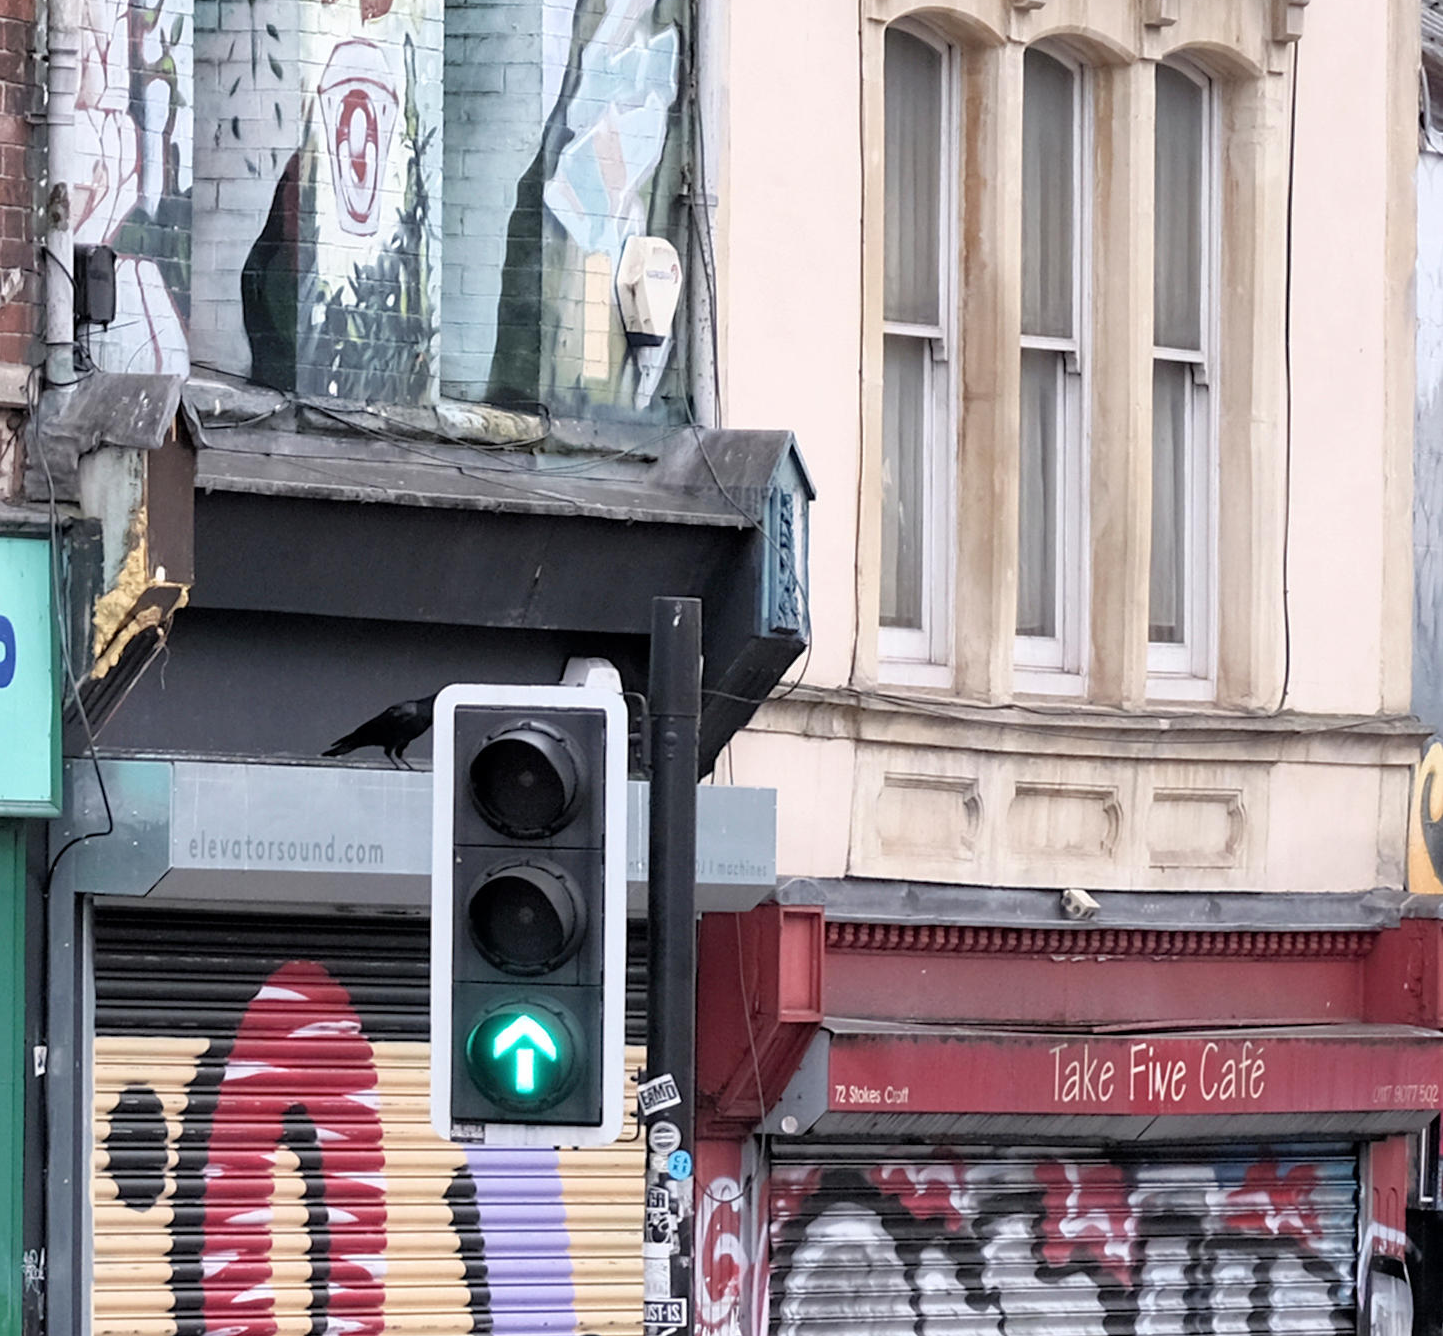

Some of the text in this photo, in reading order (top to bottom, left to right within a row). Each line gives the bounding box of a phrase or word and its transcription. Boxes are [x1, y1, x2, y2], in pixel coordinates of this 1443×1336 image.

[189, 830, 385, 865] elevatorsound.com
[1050, 1041, 1266, 1102] Take Five Café
[835, 1085, 846, 1103] 72
[849, 1085, 881, 1104] Stokes
